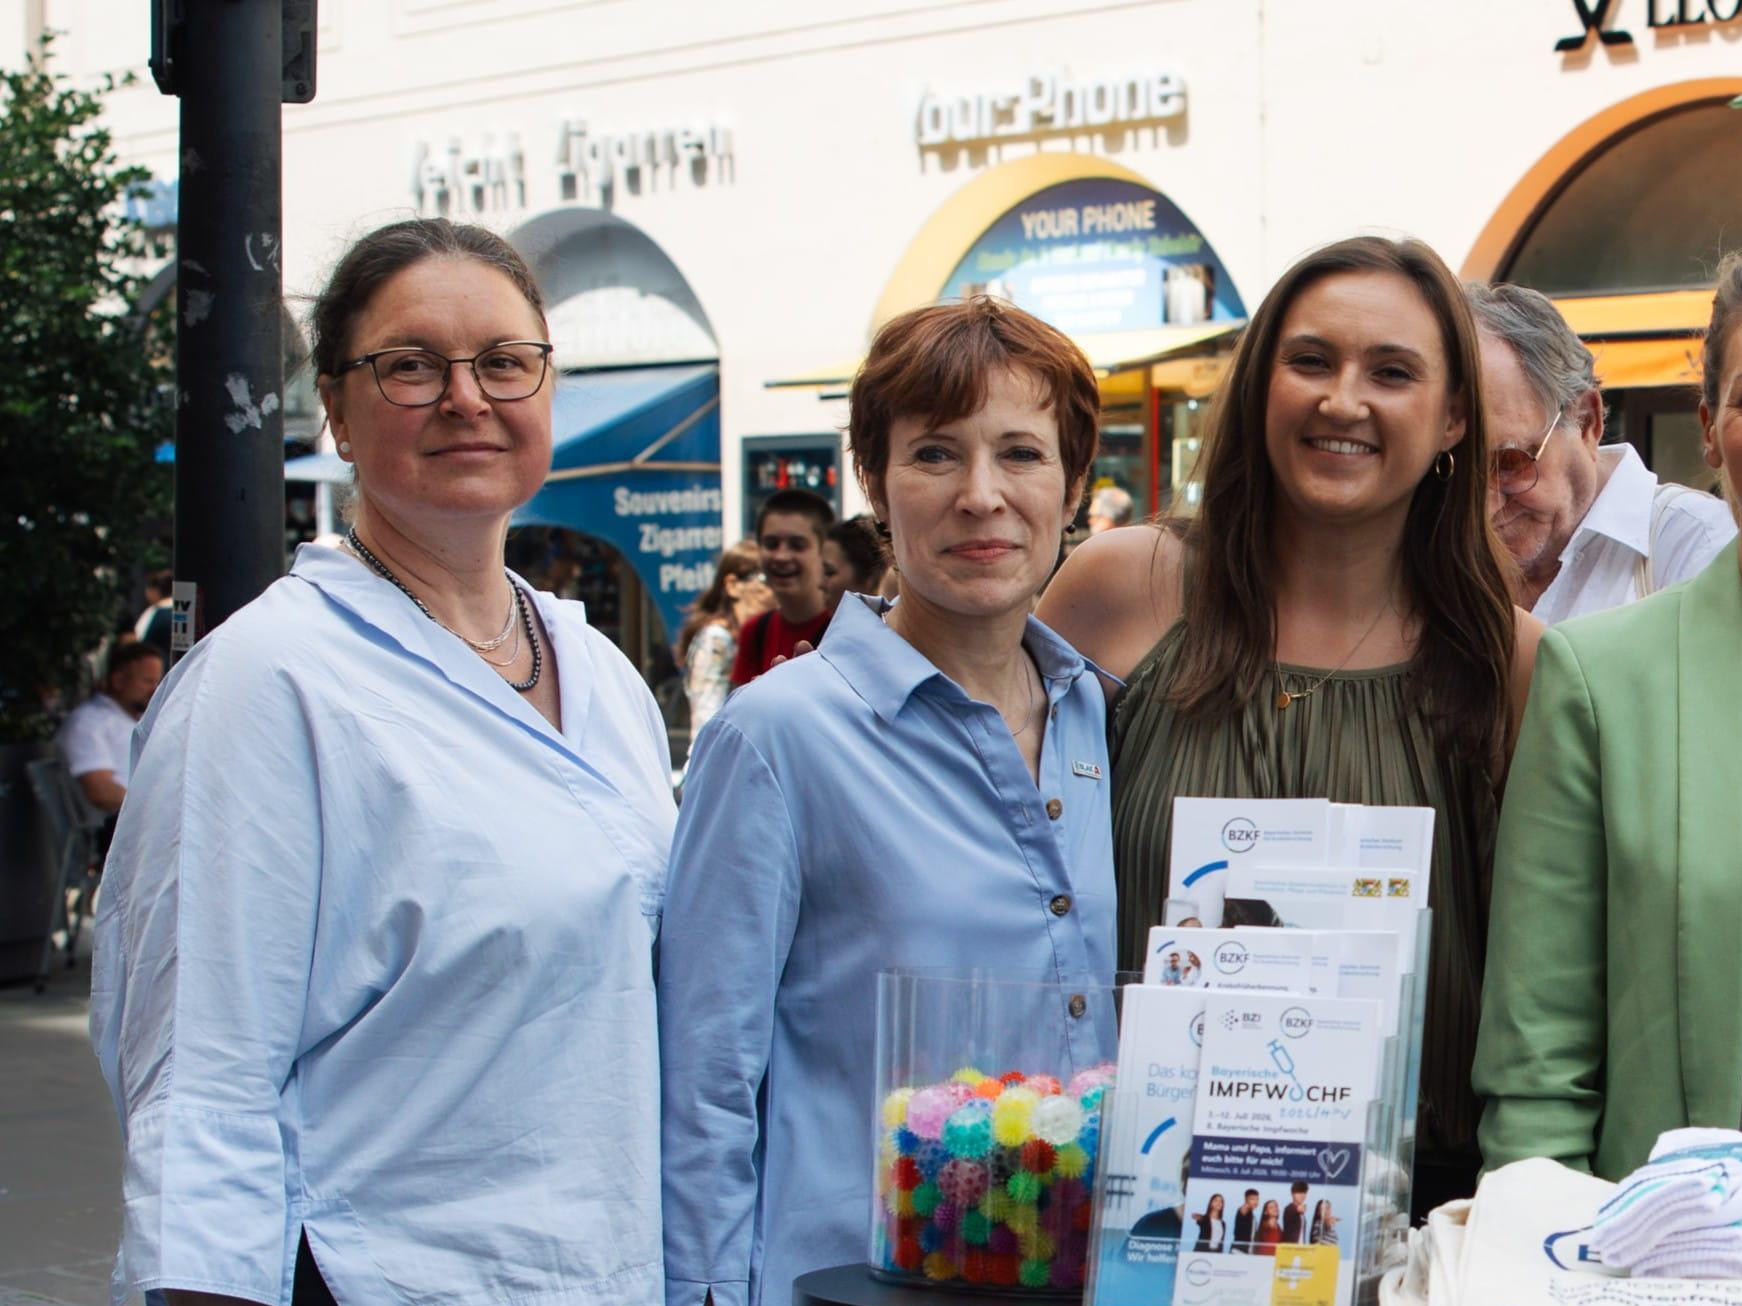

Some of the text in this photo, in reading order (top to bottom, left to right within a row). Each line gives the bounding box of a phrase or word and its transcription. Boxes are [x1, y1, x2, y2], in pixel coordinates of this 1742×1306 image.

[1021, 200, 1156, 240] YOUR PHONE
[1228, 830, 1261, 841] BZKF
[1219, 952, 1250, 964] BZKF
[1285, 1018, 1314, 1029] BZKF
